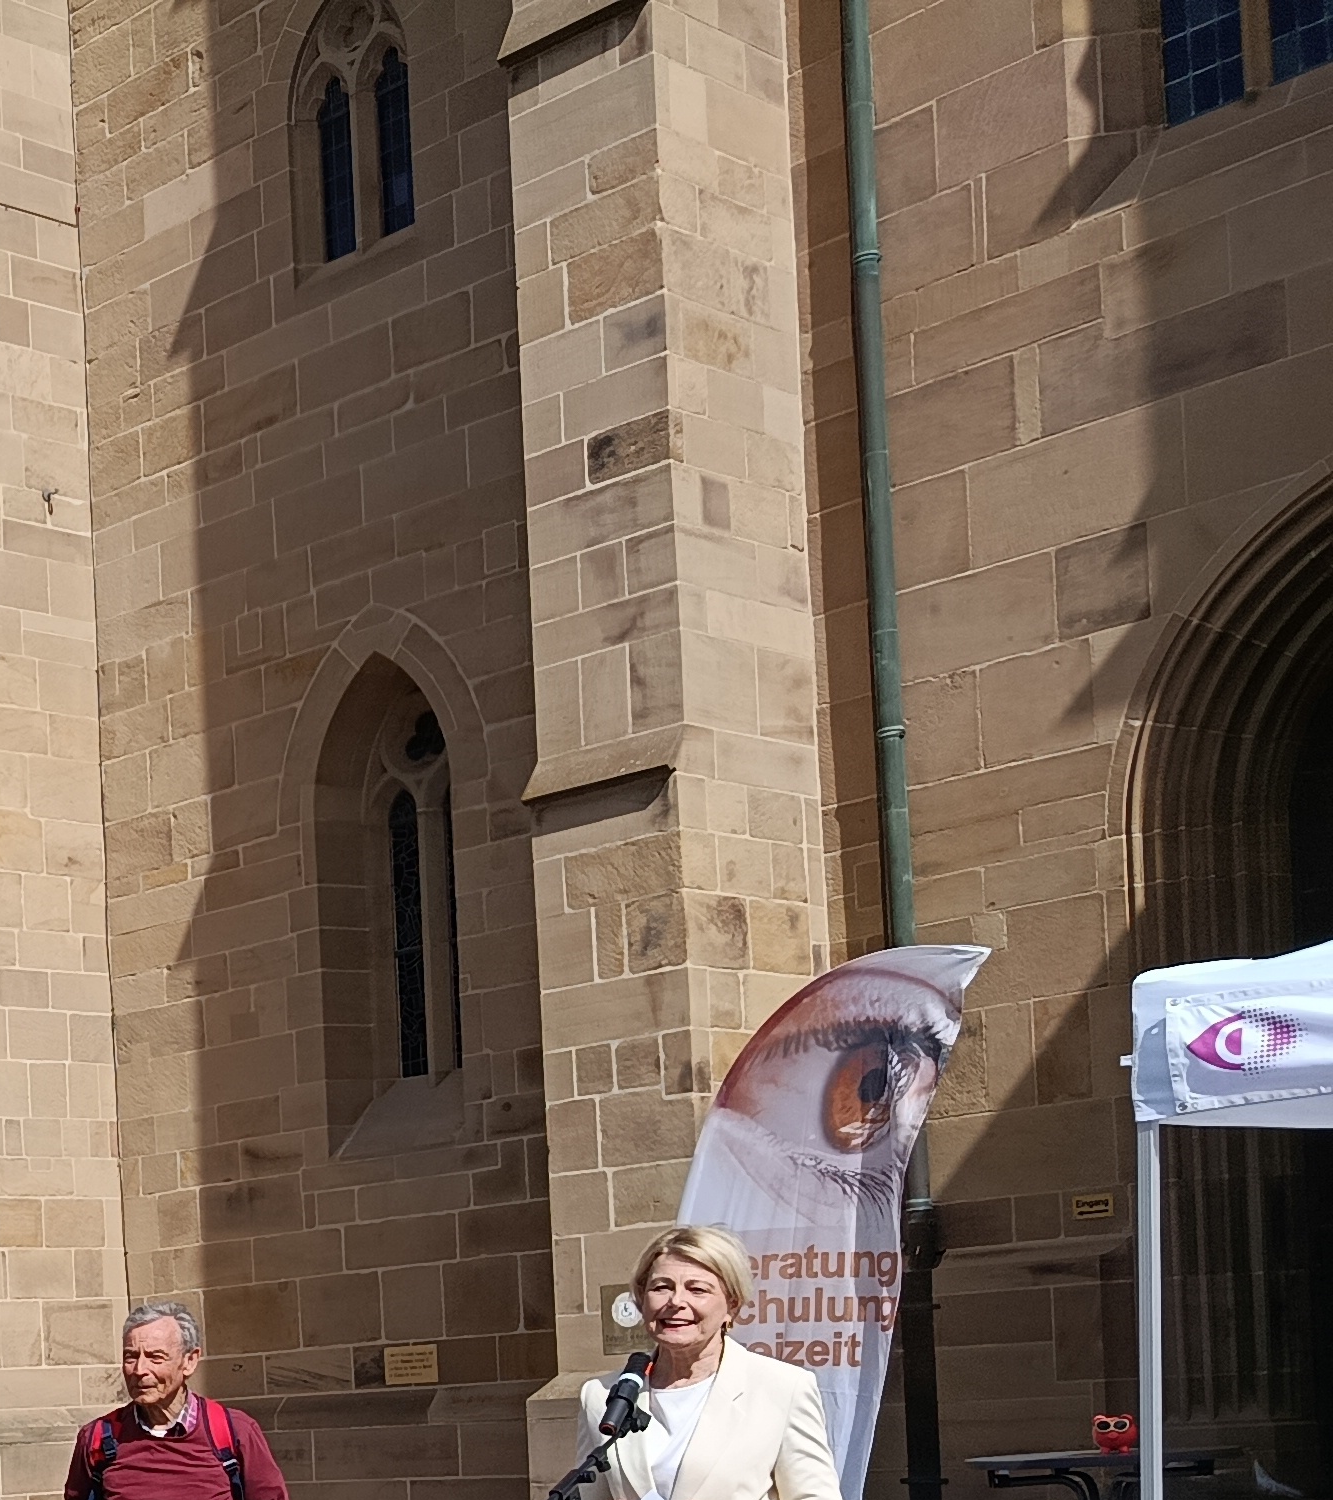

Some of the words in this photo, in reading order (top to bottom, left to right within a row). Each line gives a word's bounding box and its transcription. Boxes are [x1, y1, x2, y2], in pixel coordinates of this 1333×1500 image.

[1075, 1198, 1109, 1209] Eingang
[747, 1244, 898, 1287] ratung
[734, 1287, 898, 1332] chulung
[743, 1331, 861, 1368] eizeit
